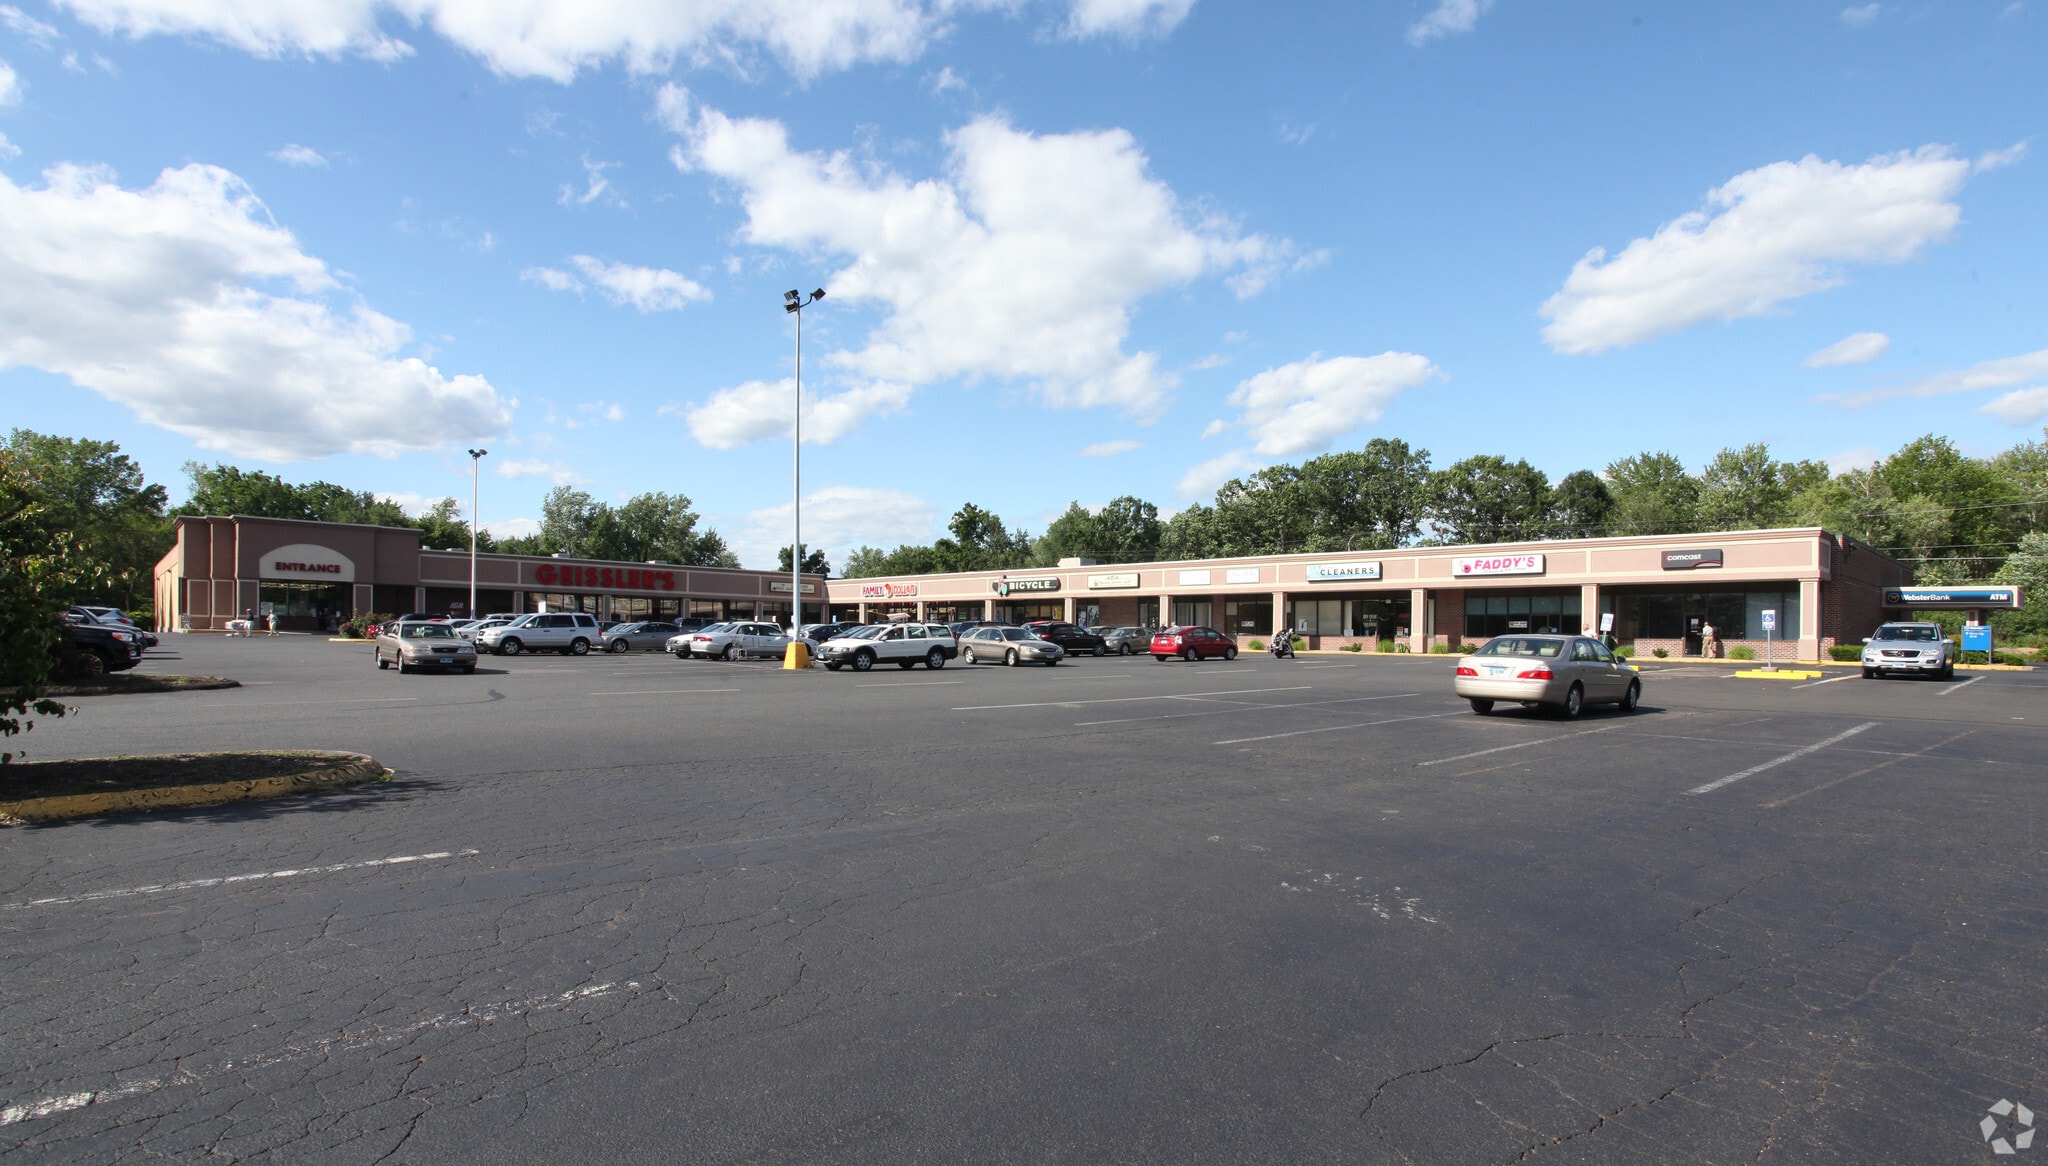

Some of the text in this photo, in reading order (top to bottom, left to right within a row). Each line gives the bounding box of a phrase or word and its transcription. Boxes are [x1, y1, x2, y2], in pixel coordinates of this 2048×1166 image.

[1666, 553, 1702, 561] comcast
[275, 562, 341, 573] ENTRANCE
[1474, 556, 1535, 570] FADDY'S
[1320, 567, 1375, 576] CLEANERS
[536, 564, 675, 590] GEISSLER'S
[863, 584, 915, 595] FAMILY DOLLAR
[1009, 580, 1051, 590] BICYCLE
[1990, 593, 2008, 601] ATM
